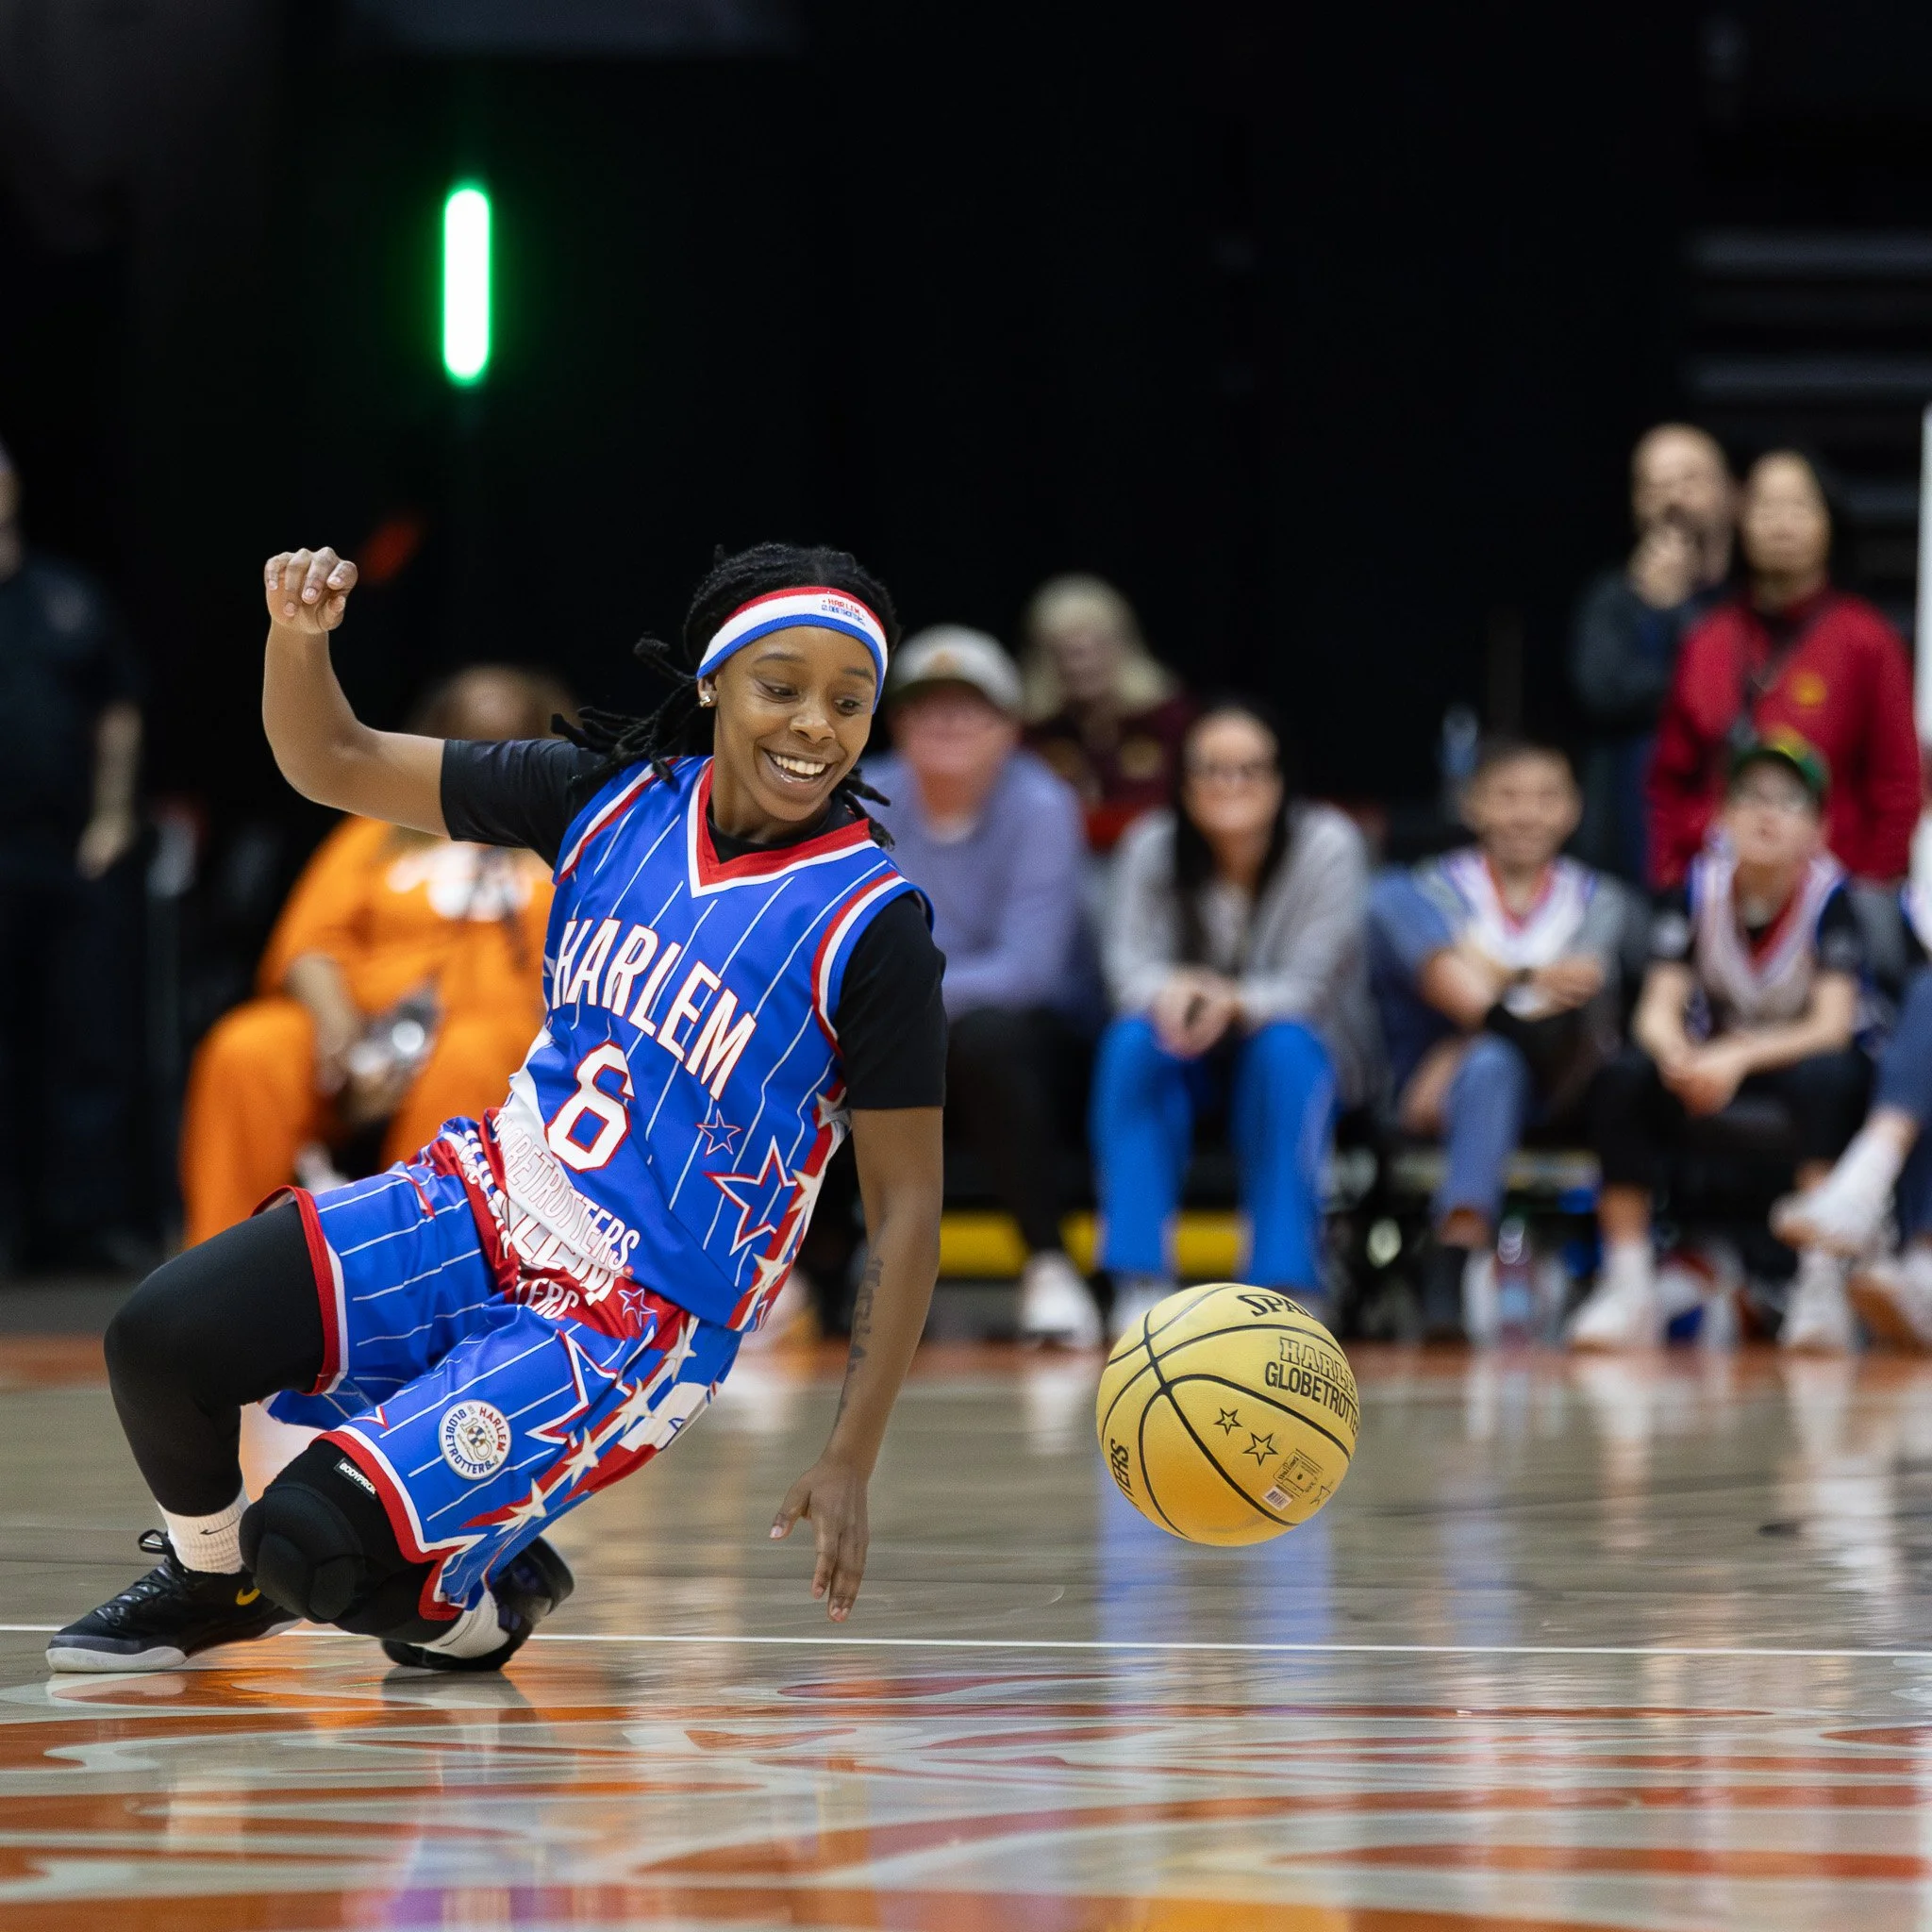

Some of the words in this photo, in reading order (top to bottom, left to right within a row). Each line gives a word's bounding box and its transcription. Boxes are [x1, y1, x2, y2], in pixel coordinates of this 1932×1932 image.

[551, 916, 758, 1102] HARLEM
[544, 1039, 636, 1174] 6
[445, 1408, 492, 1474] GLOBETROTTERS
[478, 1407, 507, 1454] HARLEM
